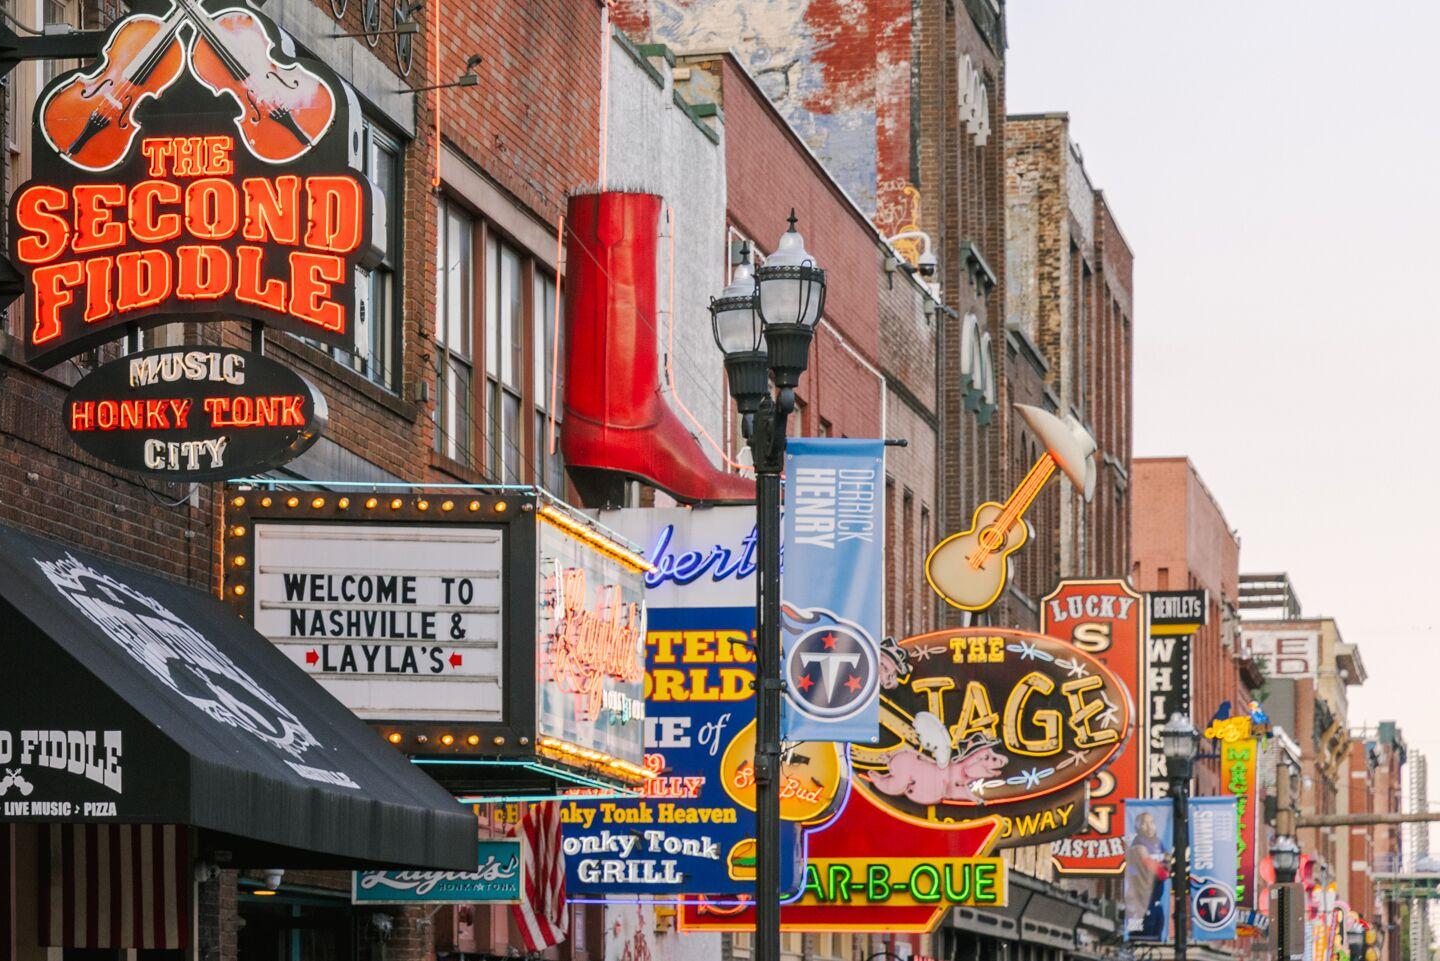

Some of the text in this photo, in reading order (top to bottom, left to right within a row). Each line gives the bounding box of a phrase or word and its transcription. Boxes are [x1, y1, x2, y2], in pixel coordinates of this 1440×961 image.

[142, 135, 235, 177] THE
[16, 176, 364, 264] SECOND
[32, 245, 346, 346] FIDDLE
[129, 351, 246, 388] MUSIC
[71, 395, 306, 432] HONKY TONK
[143, 435, 232, 471] CITY
[793, 467, 837, 550] HENRY
[837, 468, 875, 543] DERRICK
[644, 525, 758, 588] bert
[283, 573, 474, 605] WELCOME TO
[290, 608, 467, 640] NASHVILLE &
[1049, 594, 1136, 623] LUCKY
[322, 645, 445, 674] LAYLA'S
[949, 636, 1005, 664] THE
[697, 712, 731, 753] of
[1149, 638, 1176, 799] WHISKE
[21, 729, 122, 795] FIDDLE
[4, 801, 29, 816] LIVE
[31, 802, 71, 817] MUSIC
[83, 802, 117, 817] PIZZA
[779, 778, 825, 804] Bud
[561, 803, 738, 829] nky Tonk Heaven
[561, 830, 720, 860] onky Tonk
[578, 859, 684, 885] GRILL
[797, 864, 998, 904] AR-B-QUE
